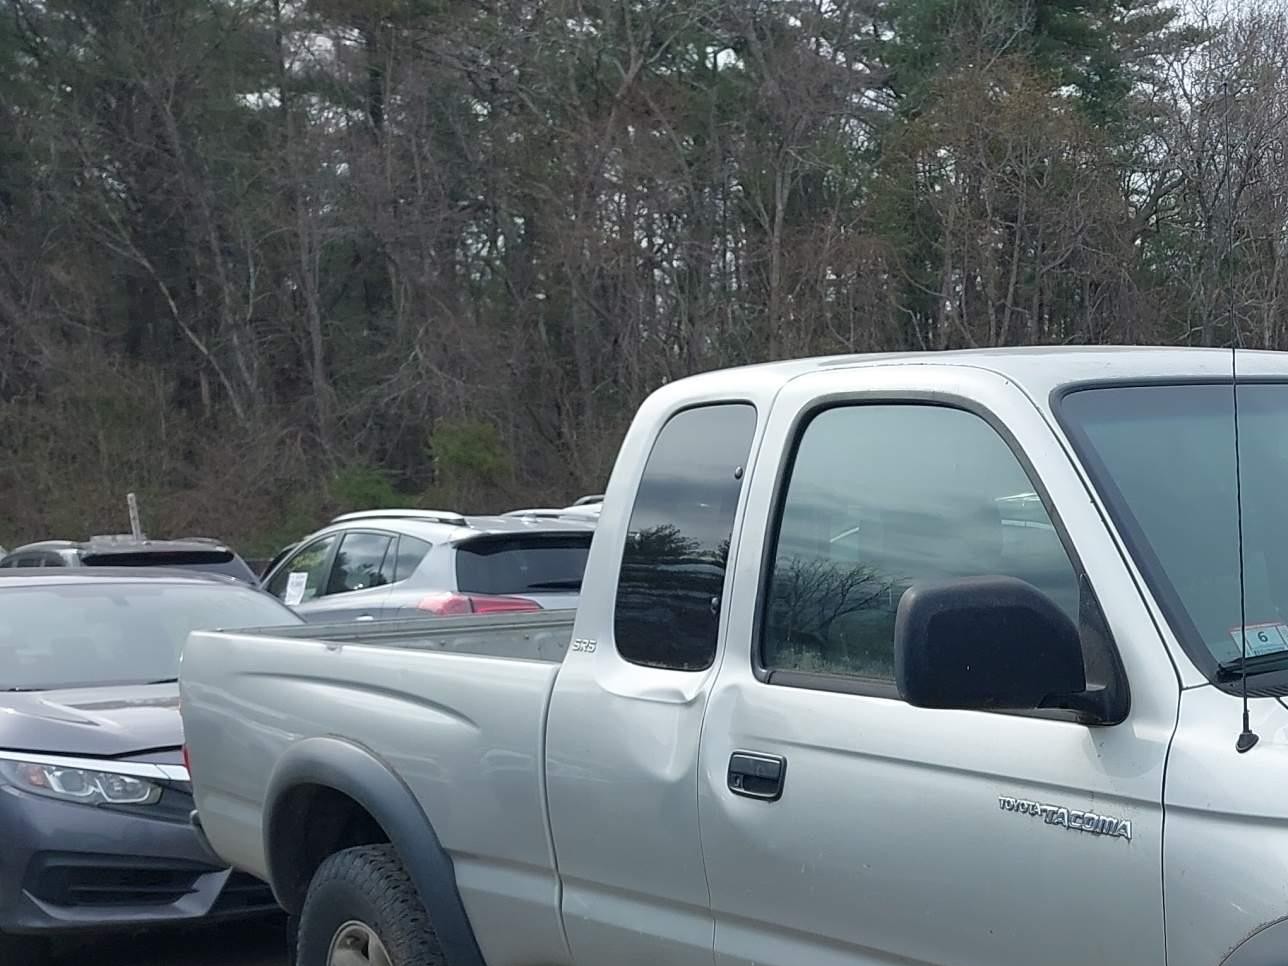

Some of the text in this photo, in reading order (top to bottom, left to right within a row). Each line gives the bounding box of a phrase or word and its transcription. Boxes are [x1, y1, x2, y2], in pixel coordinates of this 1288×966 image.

[572, 638, 598, 653] SR5
[998, 796, 1133, 840] TOYOTA TACOMA
